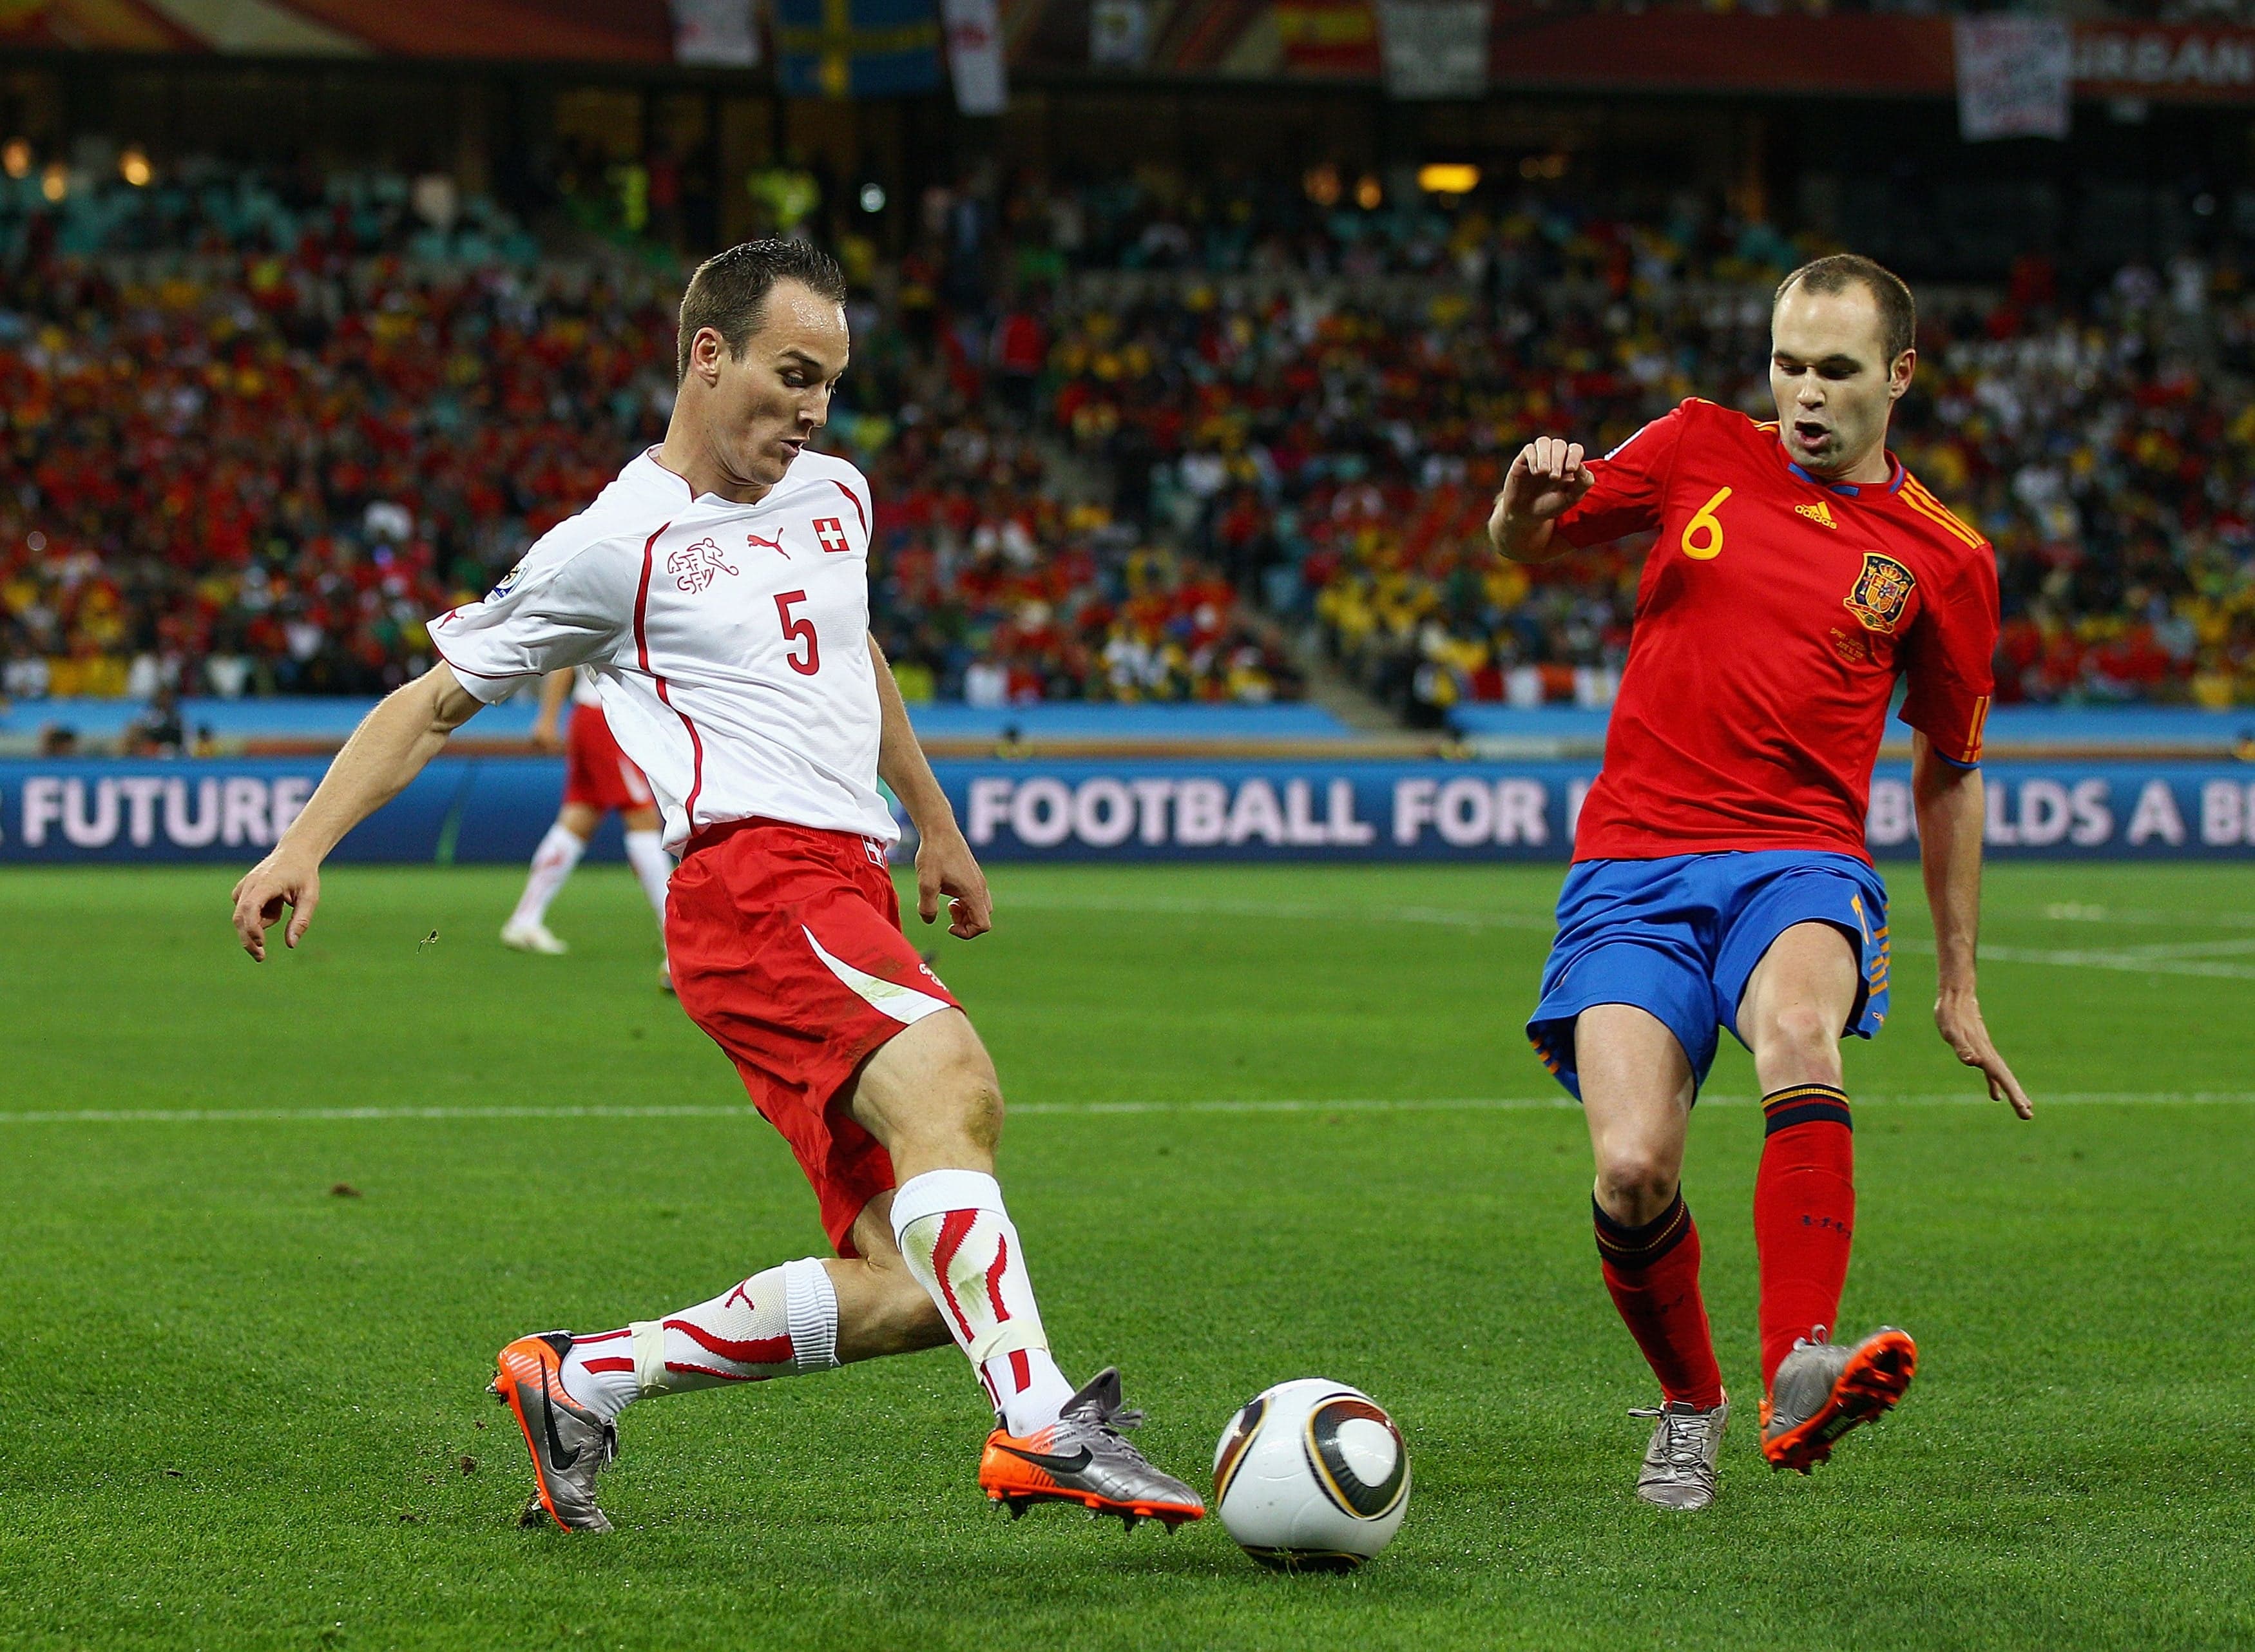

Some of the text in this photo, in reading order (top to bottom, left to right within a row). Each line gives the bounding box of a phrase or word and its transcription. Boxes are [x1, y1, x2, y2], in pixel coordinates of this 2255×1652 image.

[1681, 486, 1732, 561] 6
[1794, 503, 1838, 530] adidas
[772, 589, 820, 676] 5
[968, 776, 1376, 849] FOOTBALL
[1393, 777, 1548, 848] FOR
[1868, 778, 2114, 848] BLDS
[2126, 778, 2187, 847] A
